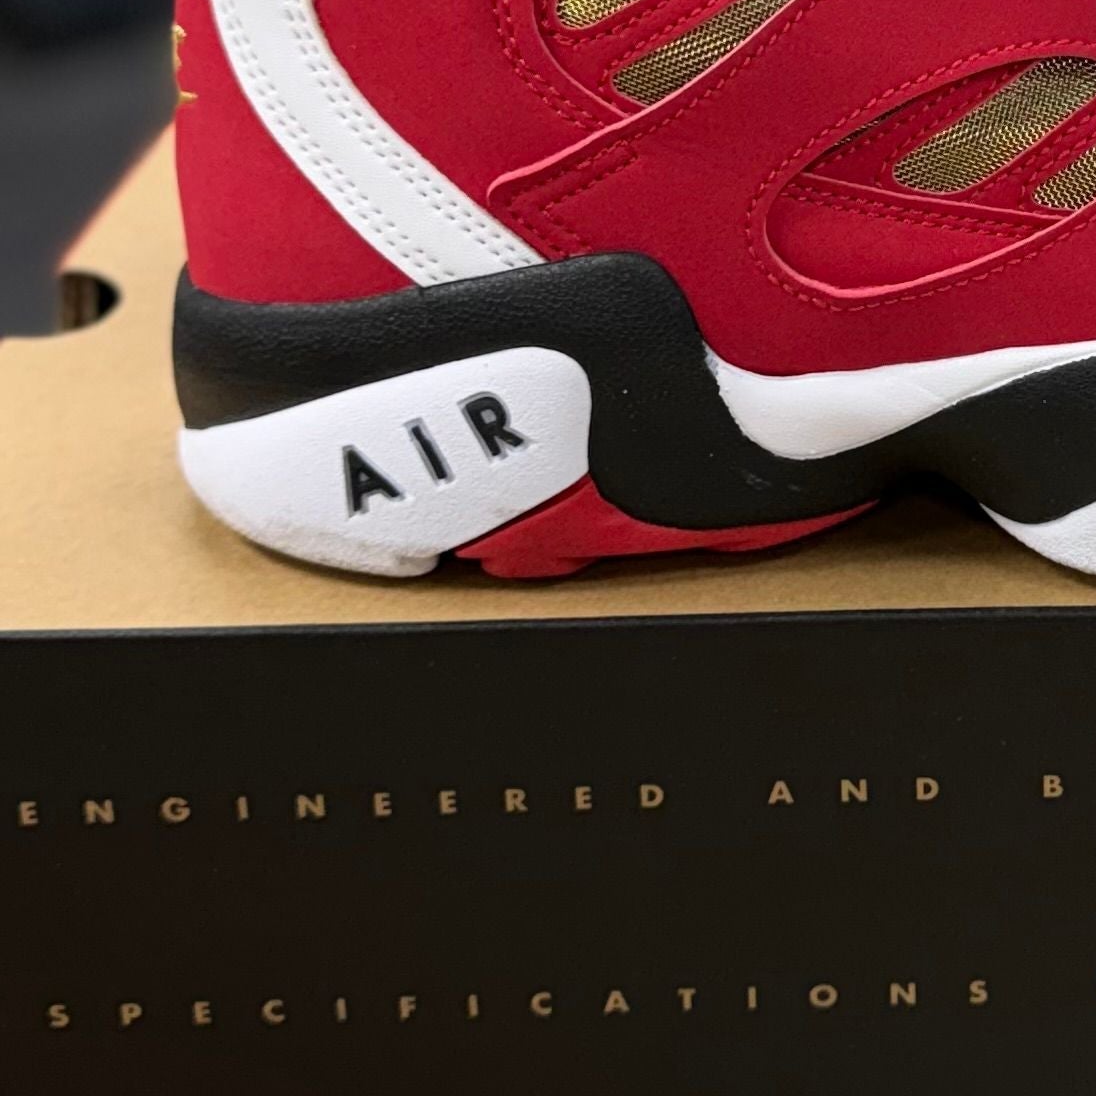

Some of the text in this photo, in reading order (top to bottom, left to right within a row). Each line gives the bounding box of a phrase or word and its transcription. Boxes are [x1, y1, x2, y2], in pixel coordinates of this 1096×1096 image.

[342, 391, 534, 518] AIR
[18, 783, 665, 826] ENGINEERED
[767, 776, 940, 805] AND
[47, 979, 989, 1028] SPECIFICATIONS
